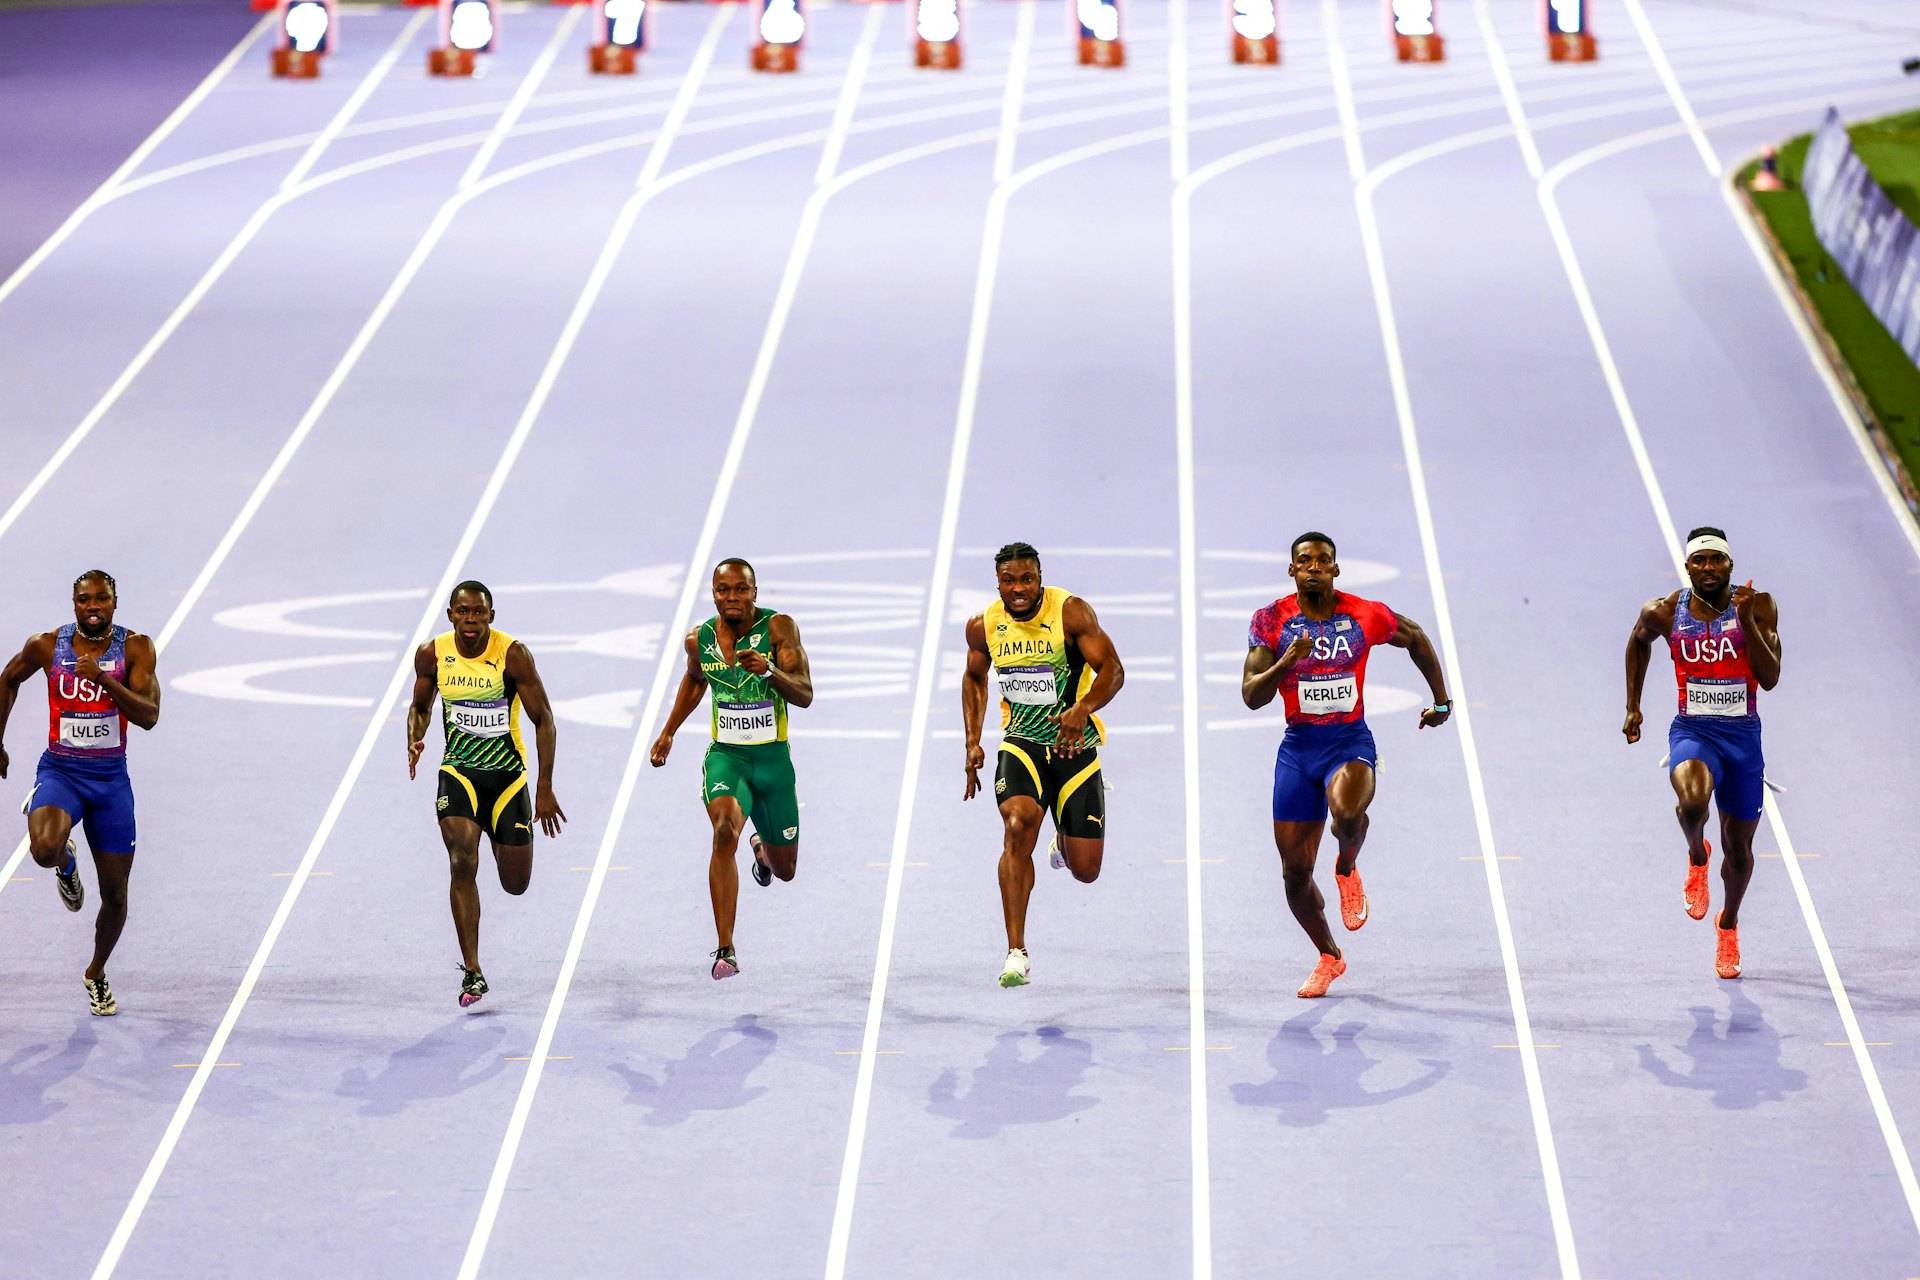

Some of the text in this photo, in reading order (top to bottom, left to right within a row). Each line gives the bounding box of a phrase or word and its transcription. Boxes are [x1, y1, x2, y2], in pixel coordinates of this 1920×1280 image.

[286, 3, 328, 52] 9
[605, 0, 646, 45] 7
[760, 0, 805, 43] 6
[997, 640, 1054, 657] JAMAICA
[1294, 635, 1353, 660] SA
[1681, 637, 1738, 663] USA
[445, 676, 493, 688] JAMAICA
[999, 679, 1054, 693] THOMPSON
[1304, 685, 1353, 701] KERLEY
[1689, 690, 1746, 705] BEDNAREK
[455, 712, 505, 728] SEVILLE
[719, 713, 773, 730] SIMBINE
[72, 724, 110, 738] LYLES
